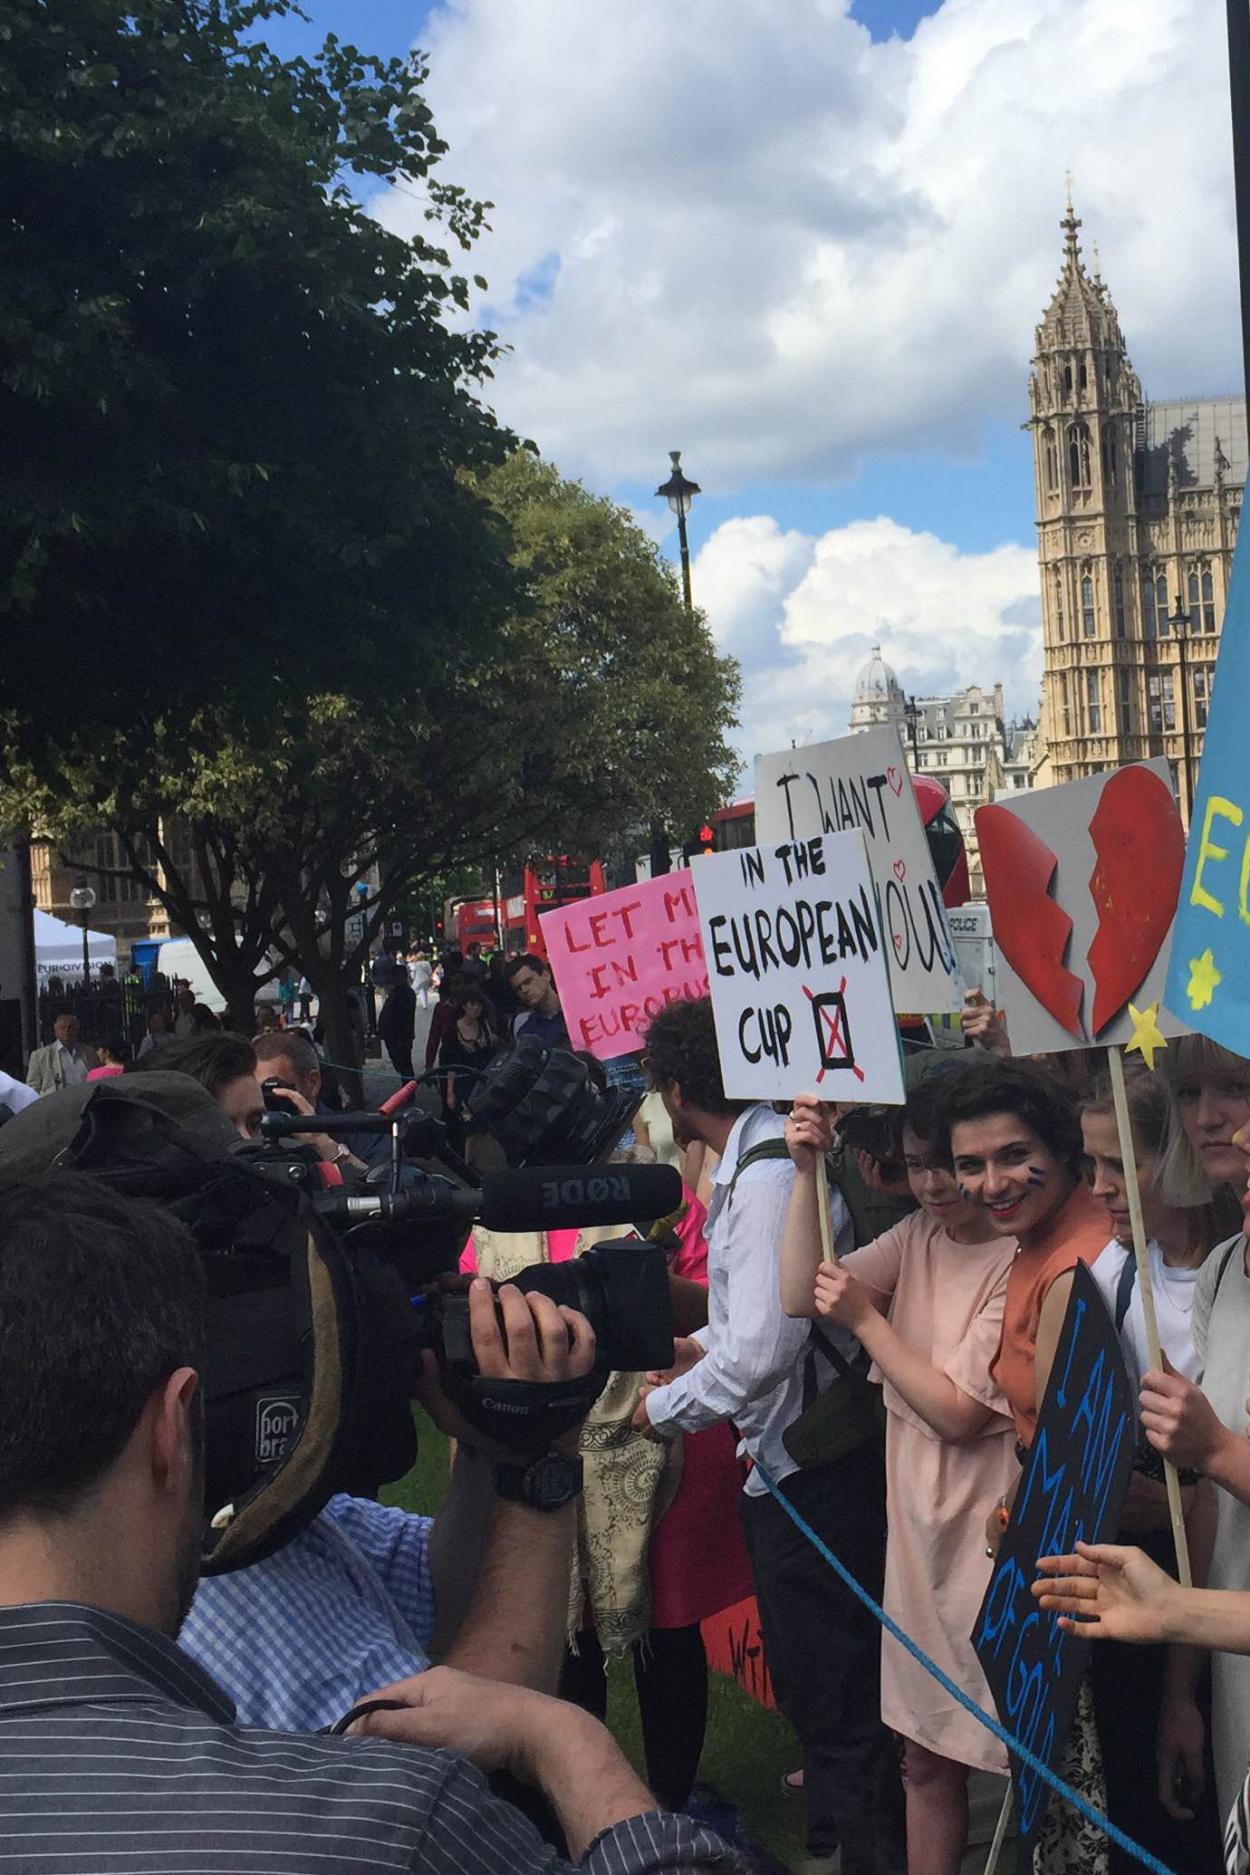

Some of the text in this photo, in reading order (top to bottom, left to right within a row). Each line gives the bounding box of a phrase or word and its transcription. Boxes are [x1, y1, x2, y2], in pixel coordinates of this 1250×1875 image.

[806, 772, 890, 843] WANT
[542, 889, 554, 901] 87
[740, 836, 827, 889] IN THE
[564, 884, 698, 953] LET M
[708, 882, 878, 982] EUROPEAN
[875, 879, 957, 976] OU
[586, 932, 704, 999] IN TH
[738, 1003, 793, 1068] CUP
[1056, 1298, 1127, 1546] I AM
